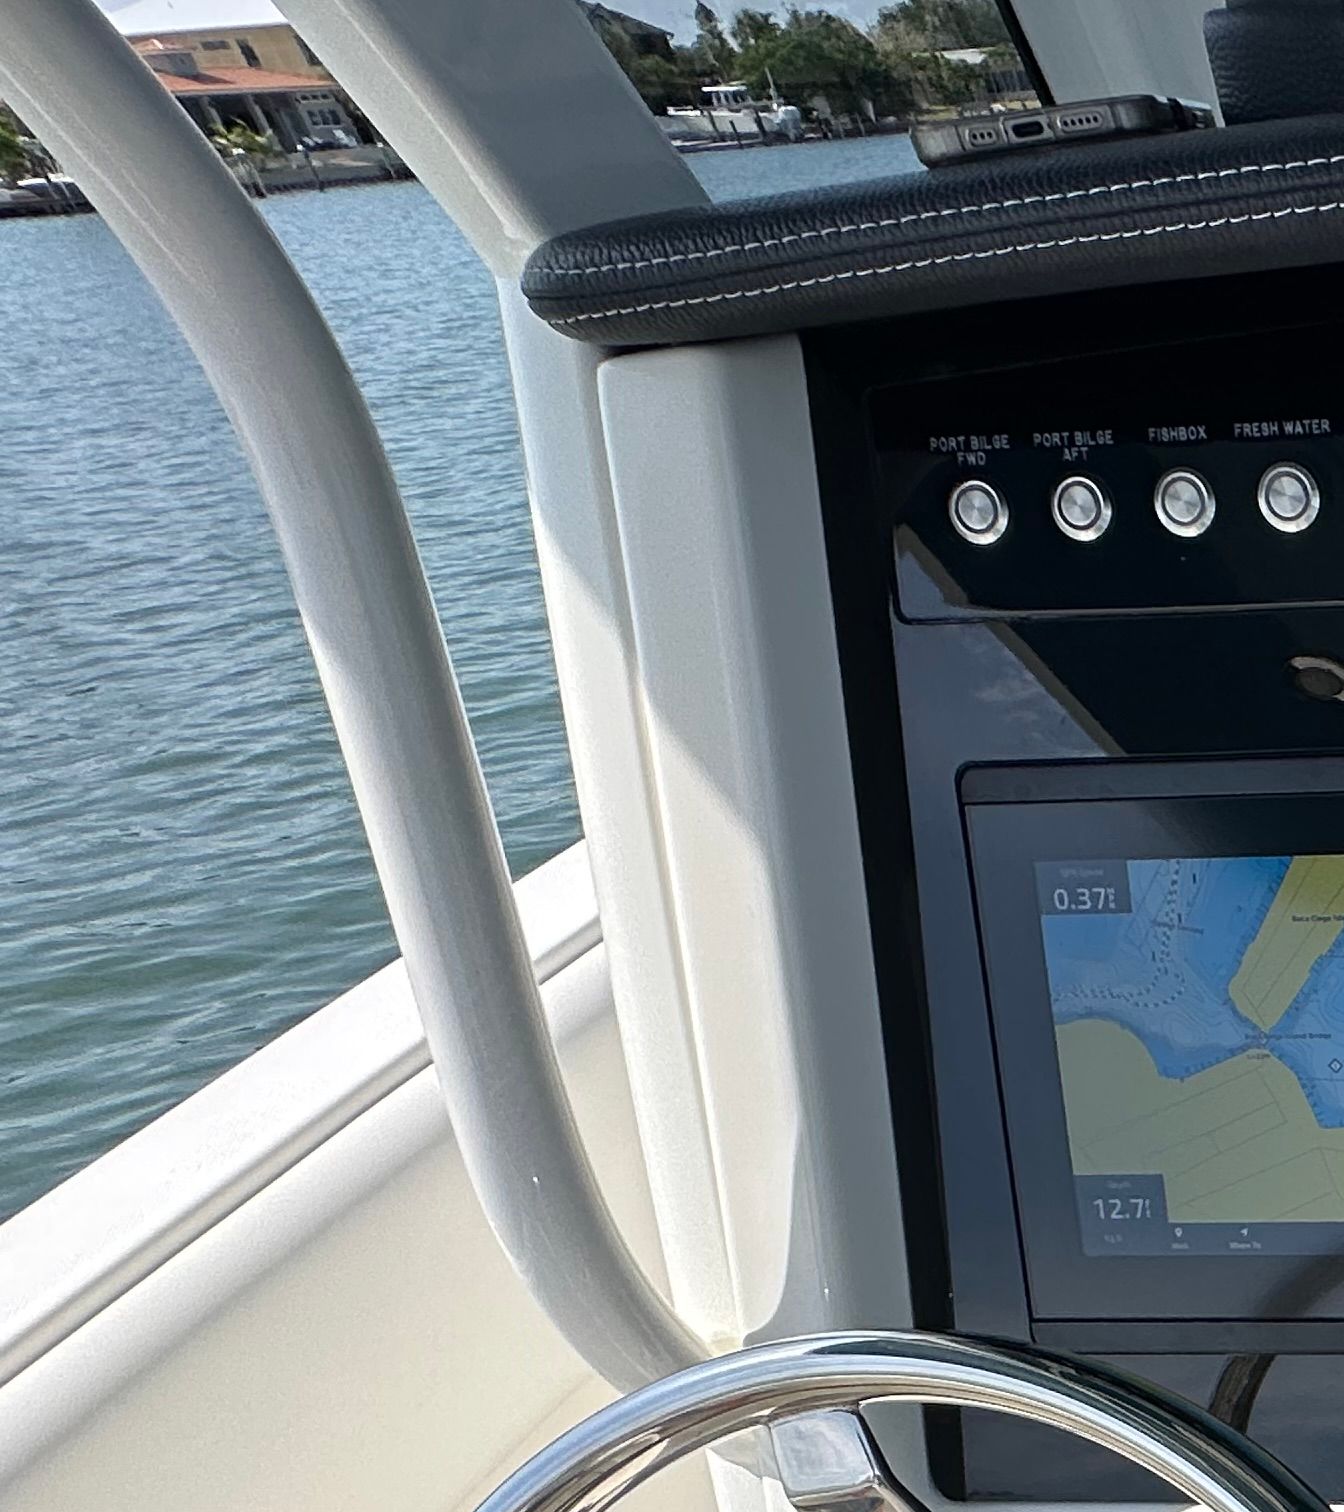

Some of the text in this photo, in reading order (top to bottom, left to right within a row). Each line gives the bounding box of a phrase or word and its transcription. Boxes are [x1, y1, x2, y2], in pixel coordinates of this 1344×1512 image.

[1148, 425, 1207, 442] FISHBOX
[1234, 418, 1331, 437] FRESH WATER
[929, 434, 1011, 451] PORT BILGE
[1033, 430, 1114, 448] PORT BILGE
[956, 451, 986, 466] FWD
[1062, 447, 1089, 462] AFT
[1054, 888, 1106, 910] 0.37
